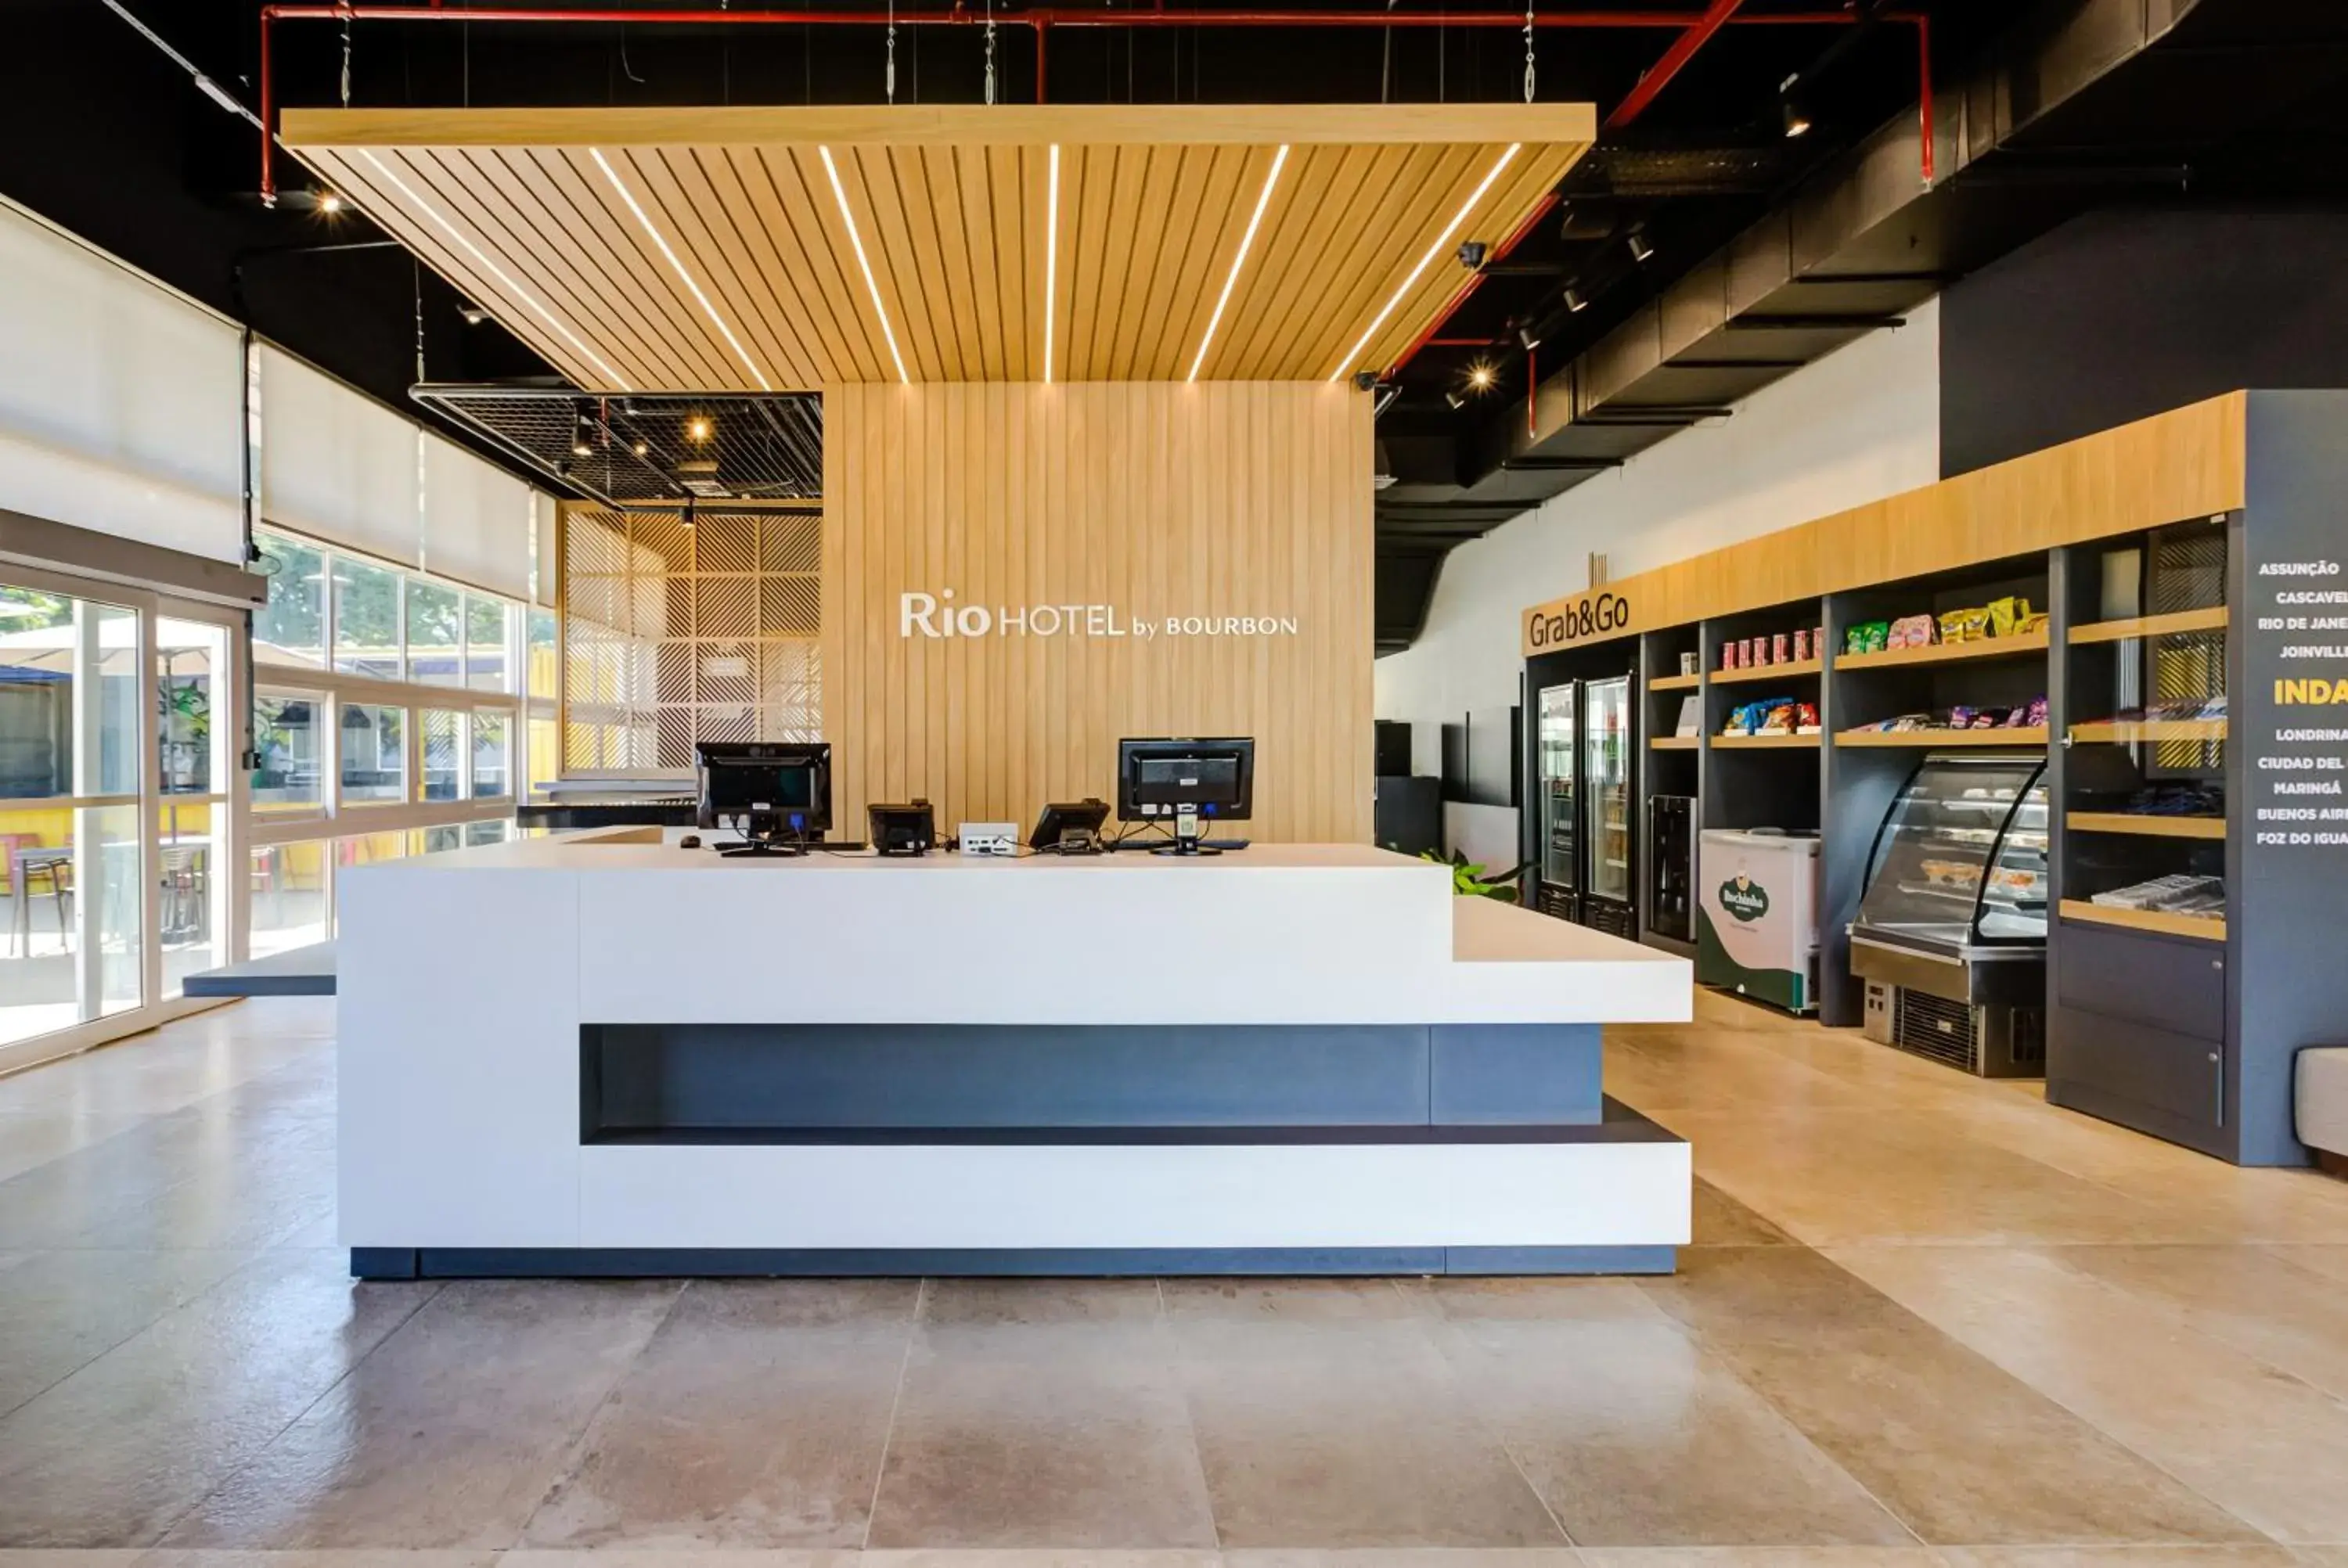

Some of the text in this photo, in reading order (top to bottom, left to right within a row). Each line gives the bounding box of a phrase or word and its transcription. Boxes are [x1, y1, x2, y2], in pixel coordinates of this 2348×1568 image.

[2259, 559, 2340, 577] ASSUNÇÃO
[901, 588, 1298, 642] Rio HOTEL by BOURBON
[1530, 592, 1629, 647] Grab&Go
[2258, 617, 2284, 630] RIO
[2287, 617, 2307, 630] DE
[2274, 678, 2348, 705] INDA
[2258, 757, 2345, 769] CIUDAD DEL
[2274, 779, 2342, 795] MARINGÁ
[2257, 808, 2317, 820] BUENOS
[2257, 833, 2285, 844] FOZ
[2289, 833, 2311, 844] DO
